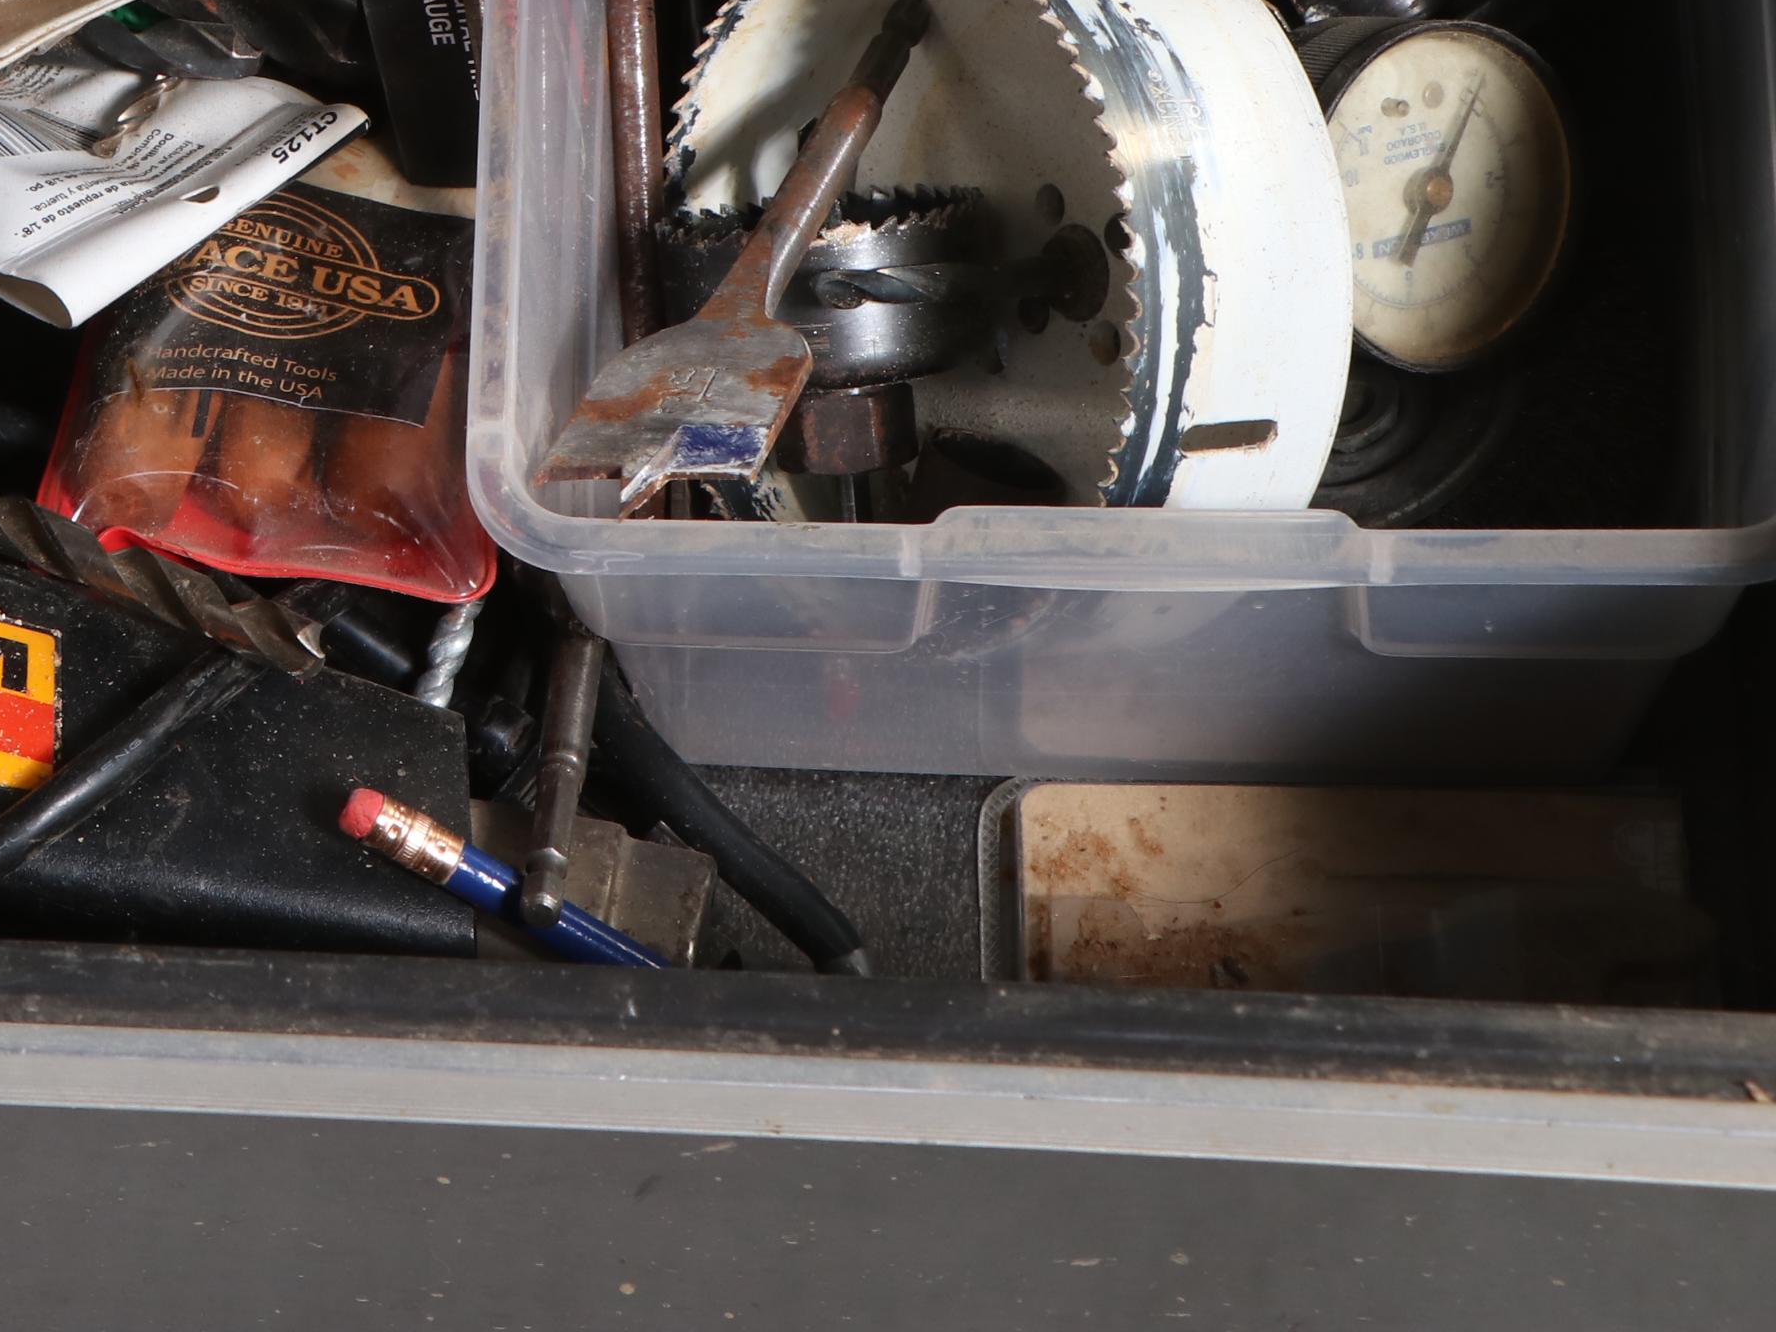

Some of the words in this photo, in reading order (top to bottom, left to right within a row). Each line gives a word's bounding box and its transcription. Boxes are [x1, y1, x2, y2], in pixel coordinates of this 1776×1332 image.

[270, 110, 337, 165] CT125
[1386, 129, 1442, 151] COLORADO
[29, 190, 68, 215] tuerca.
[55, 188, 104, 218] repuesto
[189, 238, 301, 283] ACE
[312, 264, 423, 313] USA
[189, 276, 269, 303] SINCE
[146, 343, 279, 369] Handcrafted
[282, 358, 337, 382] Tools
[149, 364, 205, 380] Made
[210, 366, 232, 380] in
[237, 368, 273, 388] the
[279, 379, 323, 399] USA
